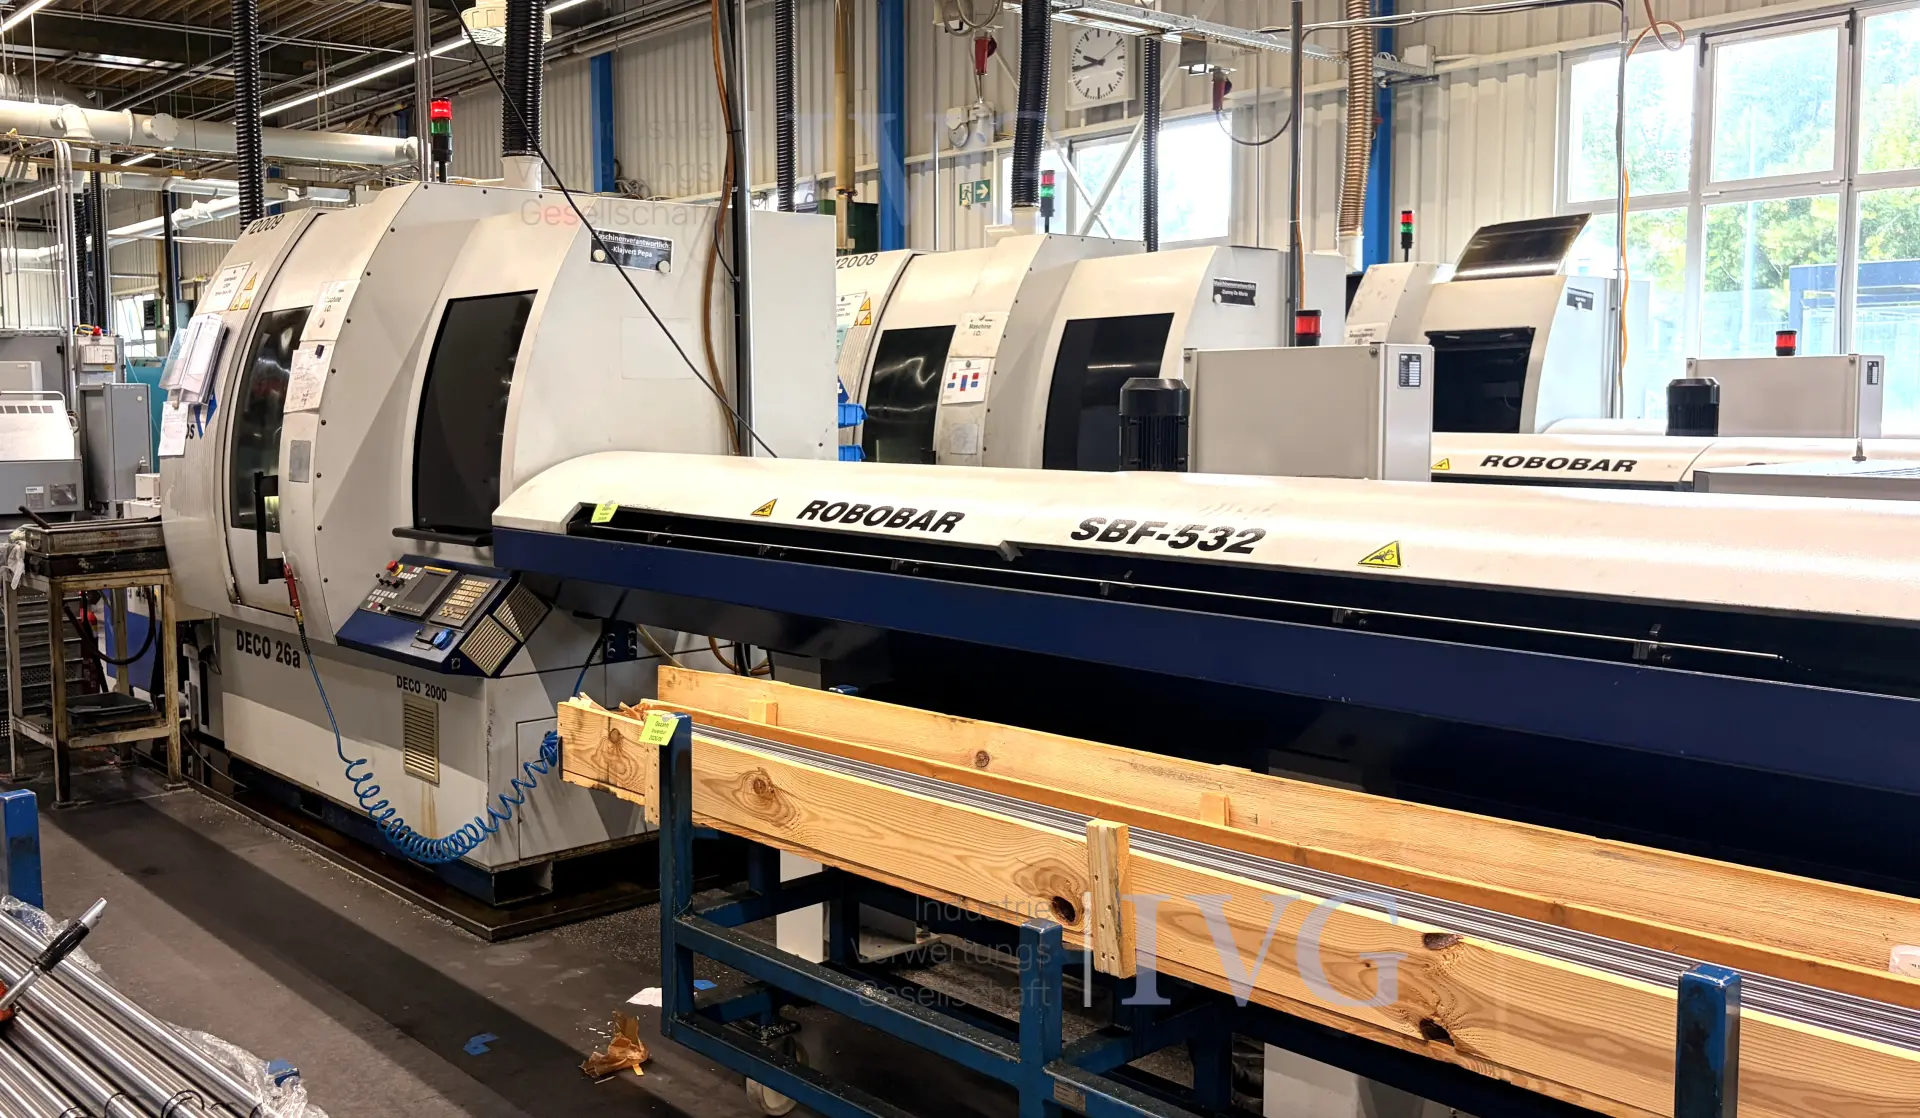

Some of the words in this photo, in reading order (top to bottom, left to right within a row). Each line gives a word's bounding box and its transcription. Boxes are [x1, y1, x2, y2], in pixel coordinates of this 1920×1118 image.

[1480, 455, 1638, 472] ROBOBAR
[796, 499, 966, 533] ROBOBAR
[1070, 517, 1267, 554] SBF-532
[236, 629, 271, 659] DECO
[276, 640, 301, 668] 26a
[396, 675, 421, 694] DECO
[424, 683, 448, 702] 2000
